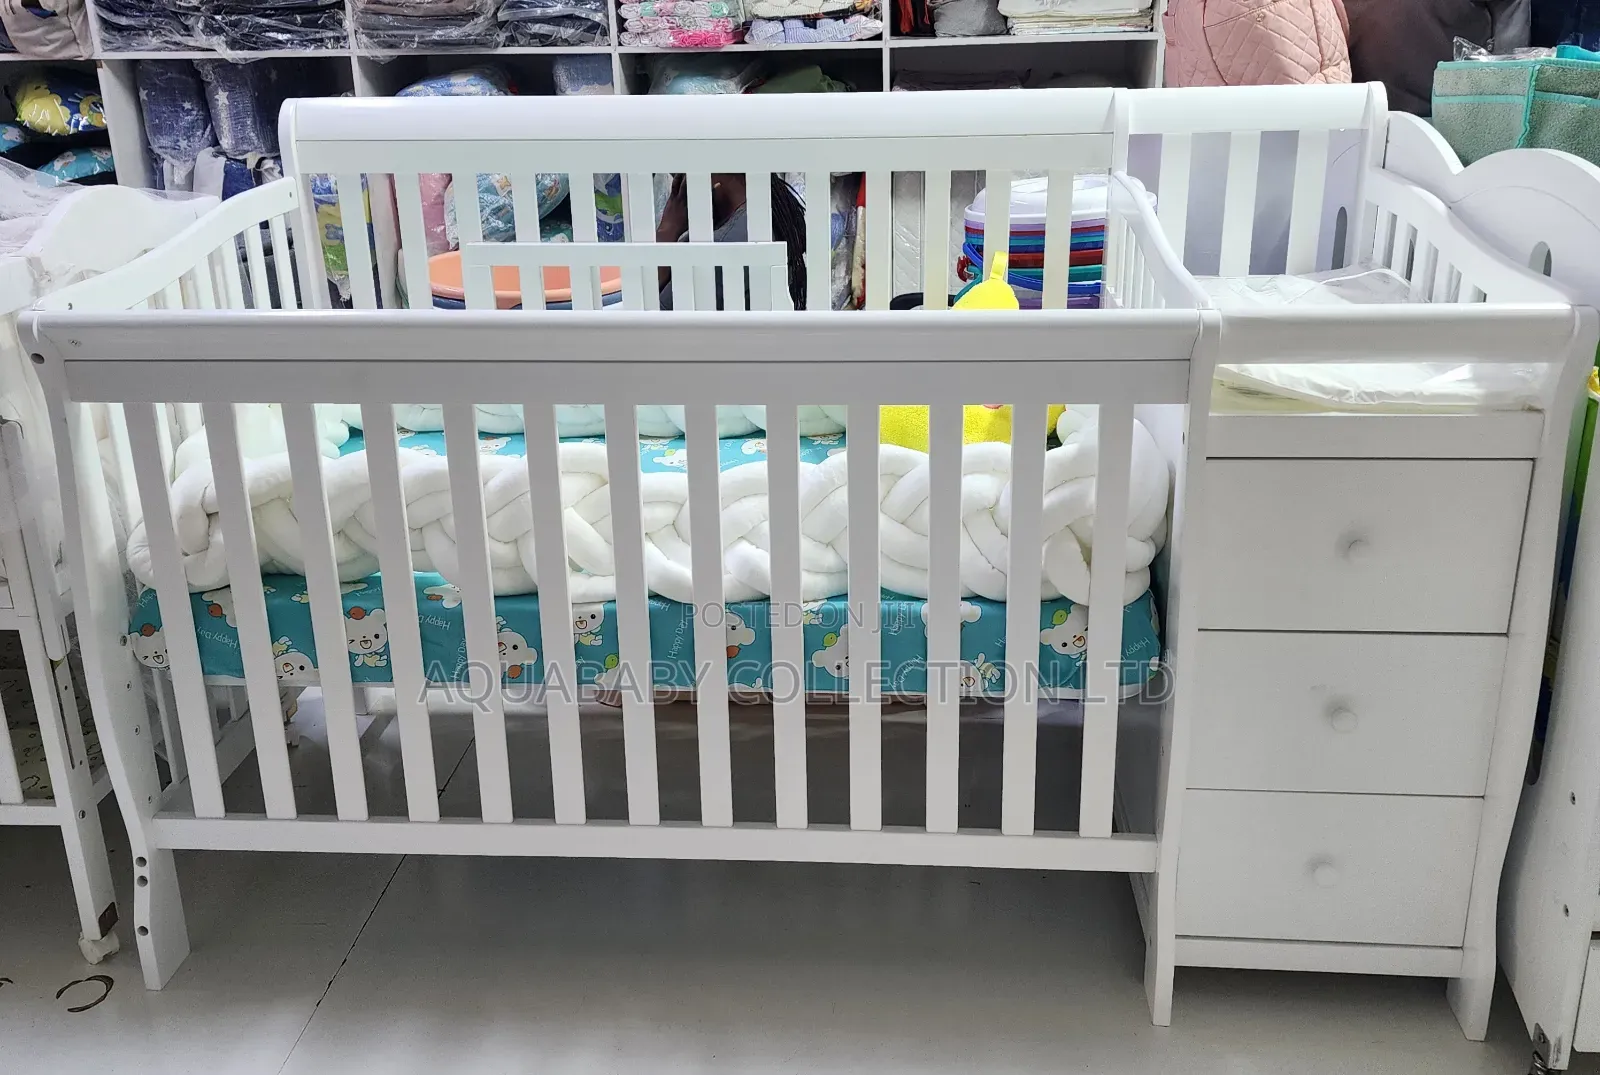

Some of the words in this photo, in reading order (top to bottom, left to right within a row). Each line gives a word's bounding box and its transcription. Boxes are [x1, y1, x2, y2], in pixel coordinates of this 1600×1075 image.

[425, 615, 451, 631] Happy
[213, 632, 239, 649] Happy
[667, 634, 684, 660] Happy
[1125, 637, 1150, 657] Happy
